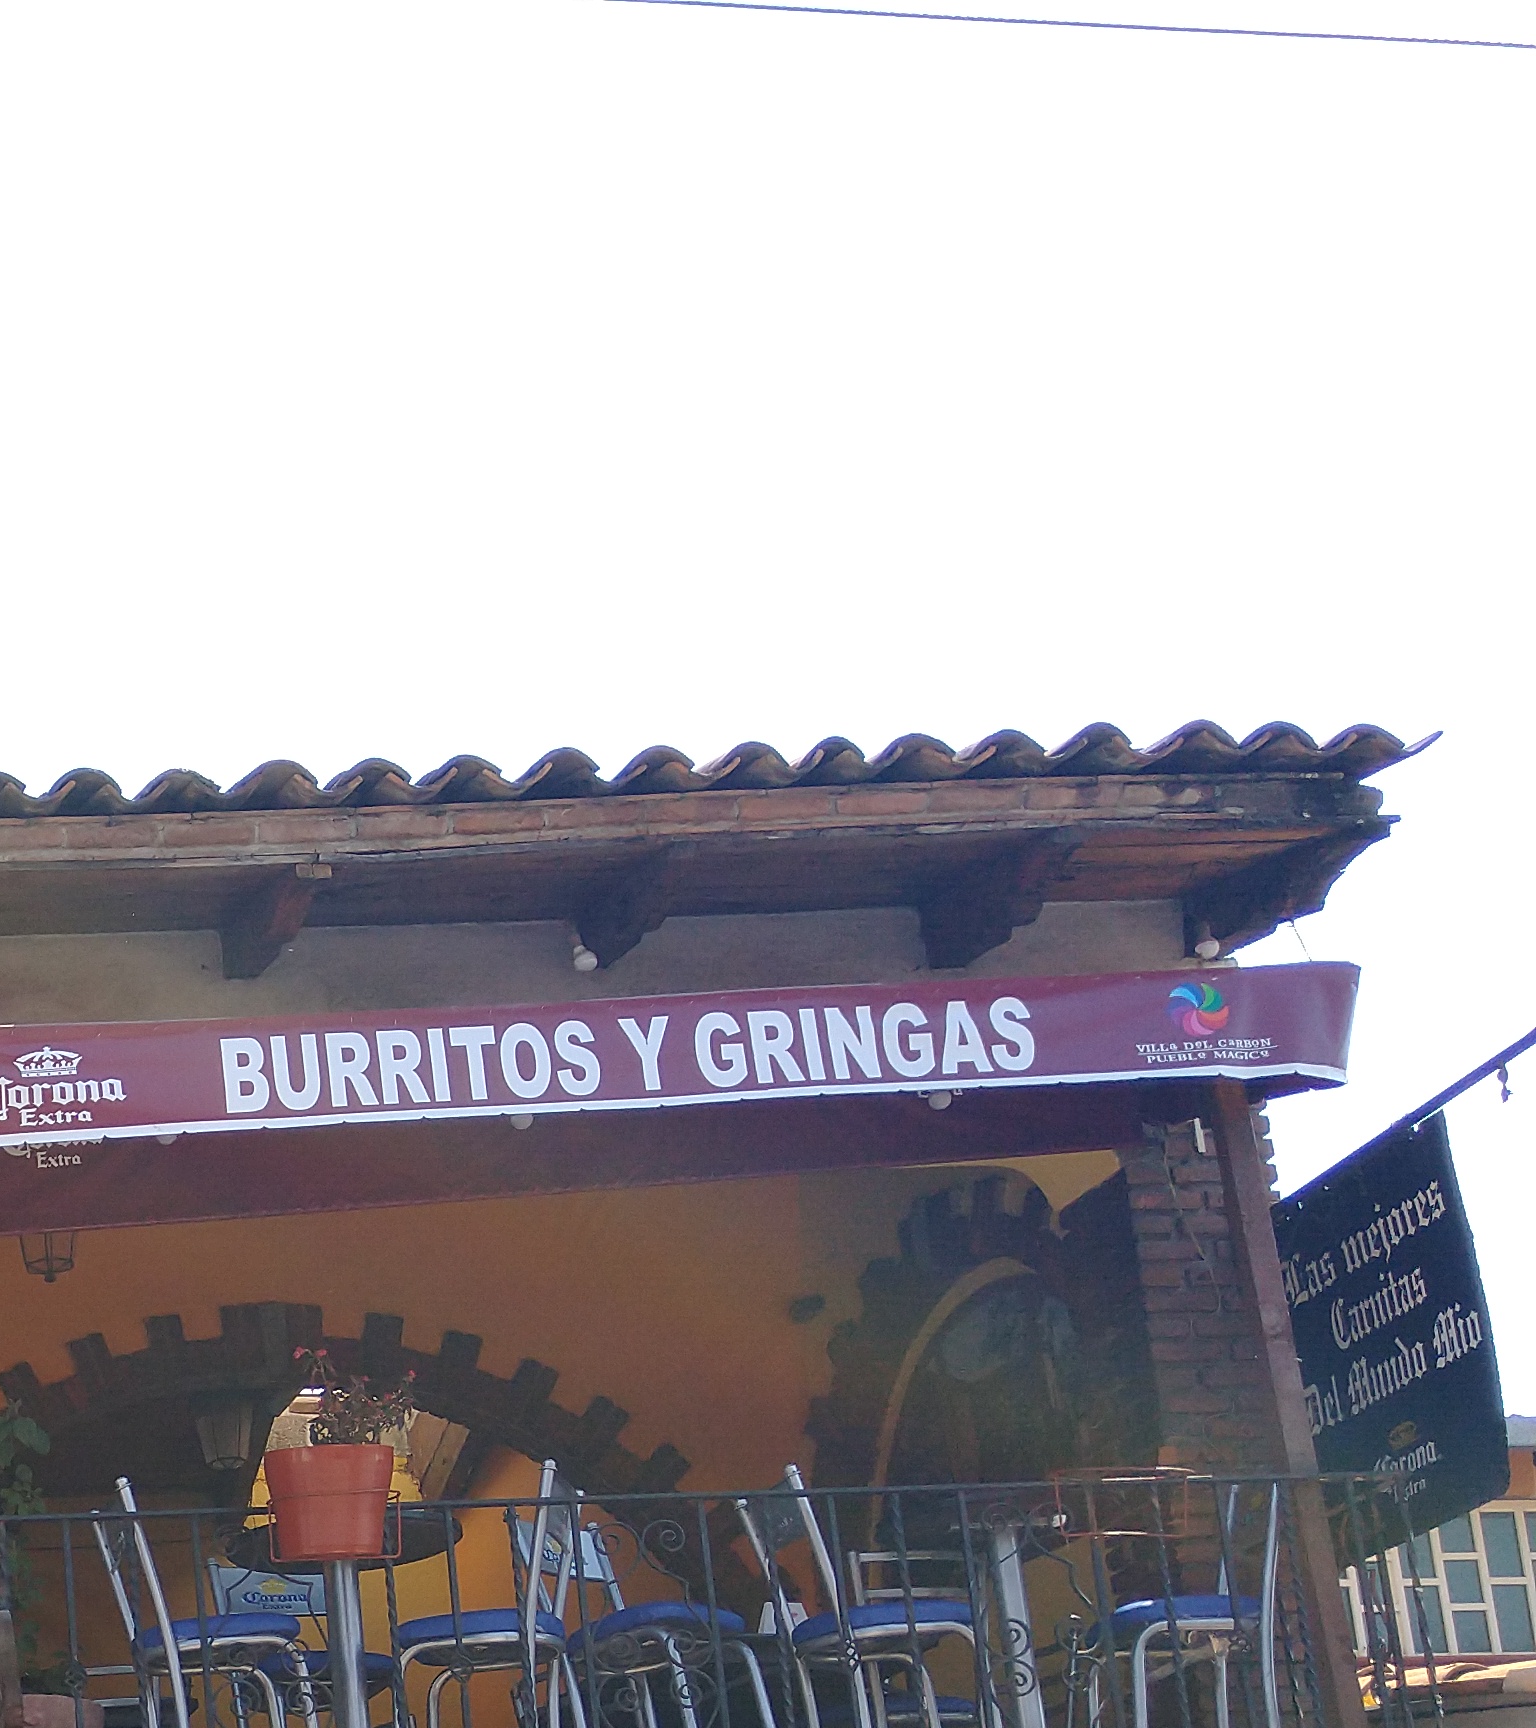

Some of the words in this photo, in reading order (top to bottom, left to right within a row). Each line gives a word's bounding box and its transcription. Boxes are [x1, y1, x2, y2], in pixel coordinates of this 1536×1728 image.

[220, 1019, 601, 1113] BURRITOS
[618, 1015, 669, 1091] Y
[694, 996, 1035, 1087] GRINGAS
[20, 1106, 93, 1127] Extra
[37, 1151, 82, 1169] Extra
[1281, 1249, 1337, 1308] Las
[1341, 1180, 1447, 1274] mejores
[1330, 1265, 1427, 1350] Carnitas
[1302, 1375, 1343, 1436] Del
[1347, 1336, 1427, 1417] Mundo
[1432, 1301, 1484, 1370] Mio
[242, 1591, 308, 1605] Corona
